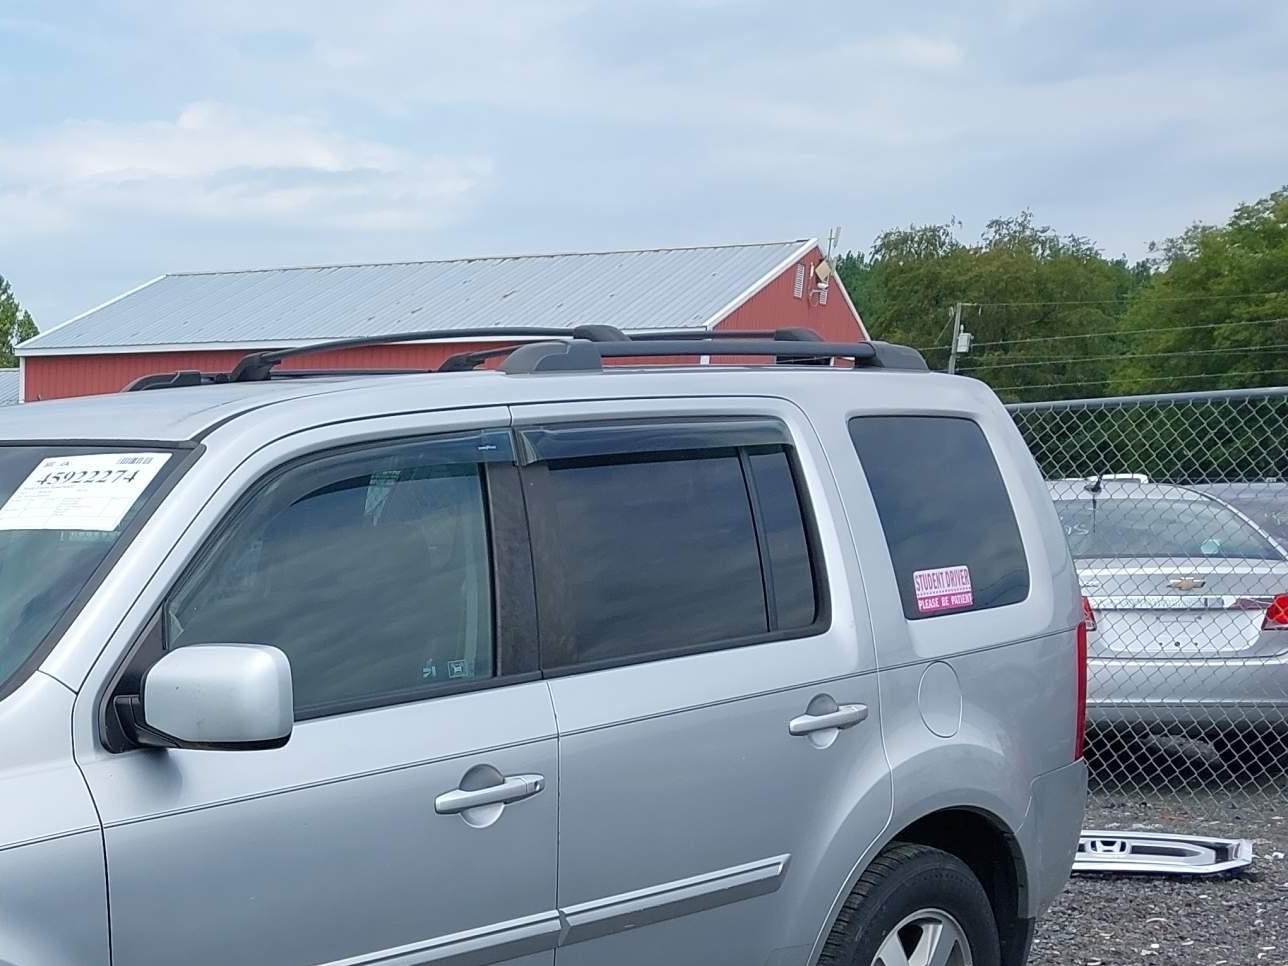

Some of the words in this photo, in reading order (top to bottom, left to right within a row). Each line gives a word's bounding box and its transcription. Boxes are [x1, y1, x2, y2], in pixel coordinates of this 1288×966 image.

[37, 470, 140, 485] 45922274
[915, 572, 945, 592] STUDENT
[946, 569, 970, 587] DRIVER
[918, 596, 941, 610] PLEASE
[951, 592, 972, 606] PATIENT
